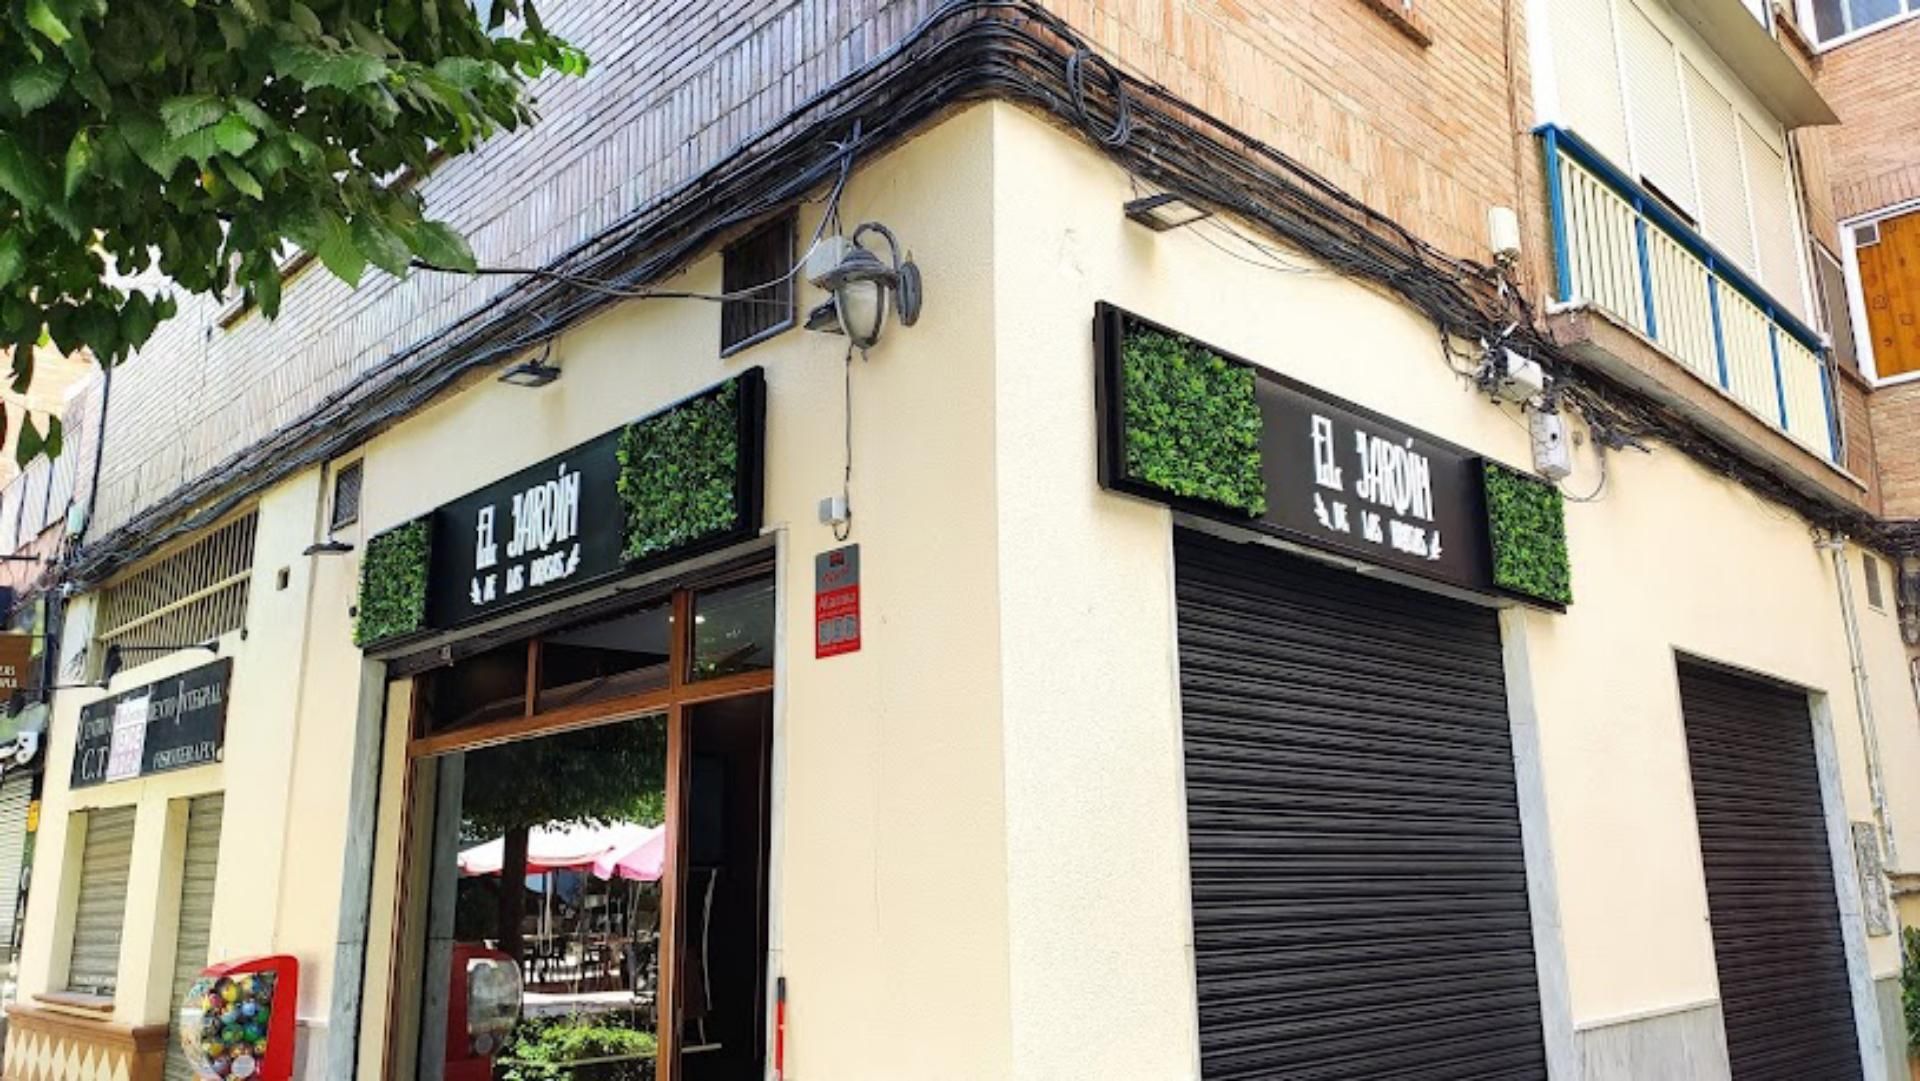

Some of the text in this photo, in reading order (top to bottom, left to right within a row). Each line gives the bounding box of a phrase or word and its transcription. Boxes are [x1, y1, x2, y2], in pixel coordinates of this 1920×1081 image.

[475, 462, 581, 570] EL JARDÍN
[1311, 414, 1434, 522] EL JARDÍN
